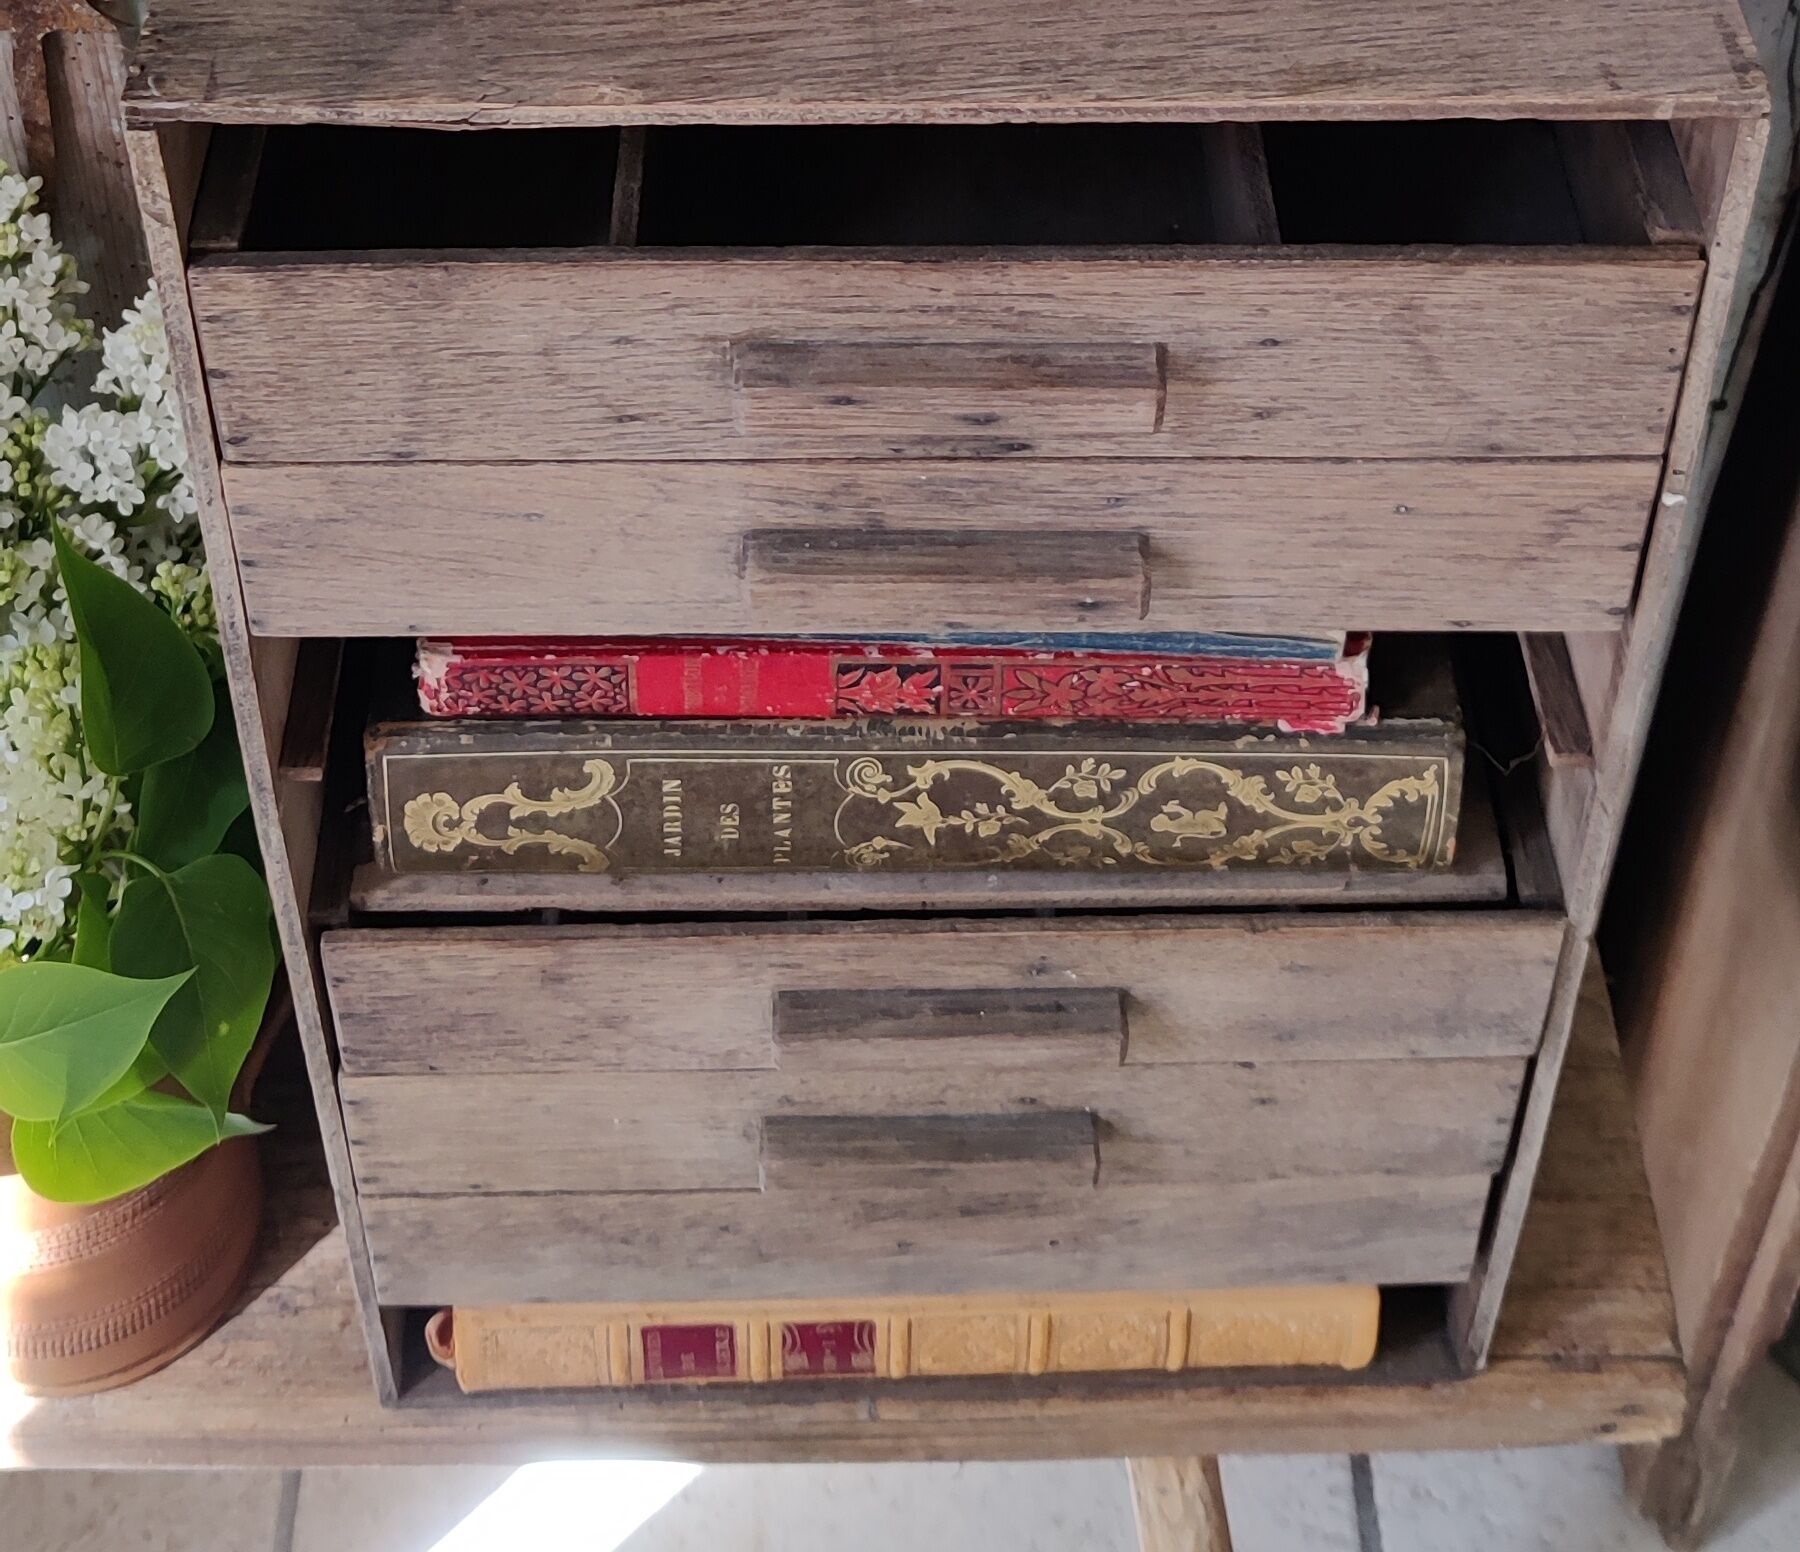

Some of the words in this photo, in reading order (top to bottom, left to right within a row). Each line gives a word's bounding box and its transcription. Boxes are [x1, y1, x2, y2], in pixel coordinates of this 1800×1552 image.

[662, 779, 683, 857] JARDIN
[719, 803, 740, 840] DES
[772, 765, 793, 864] PLANTES
